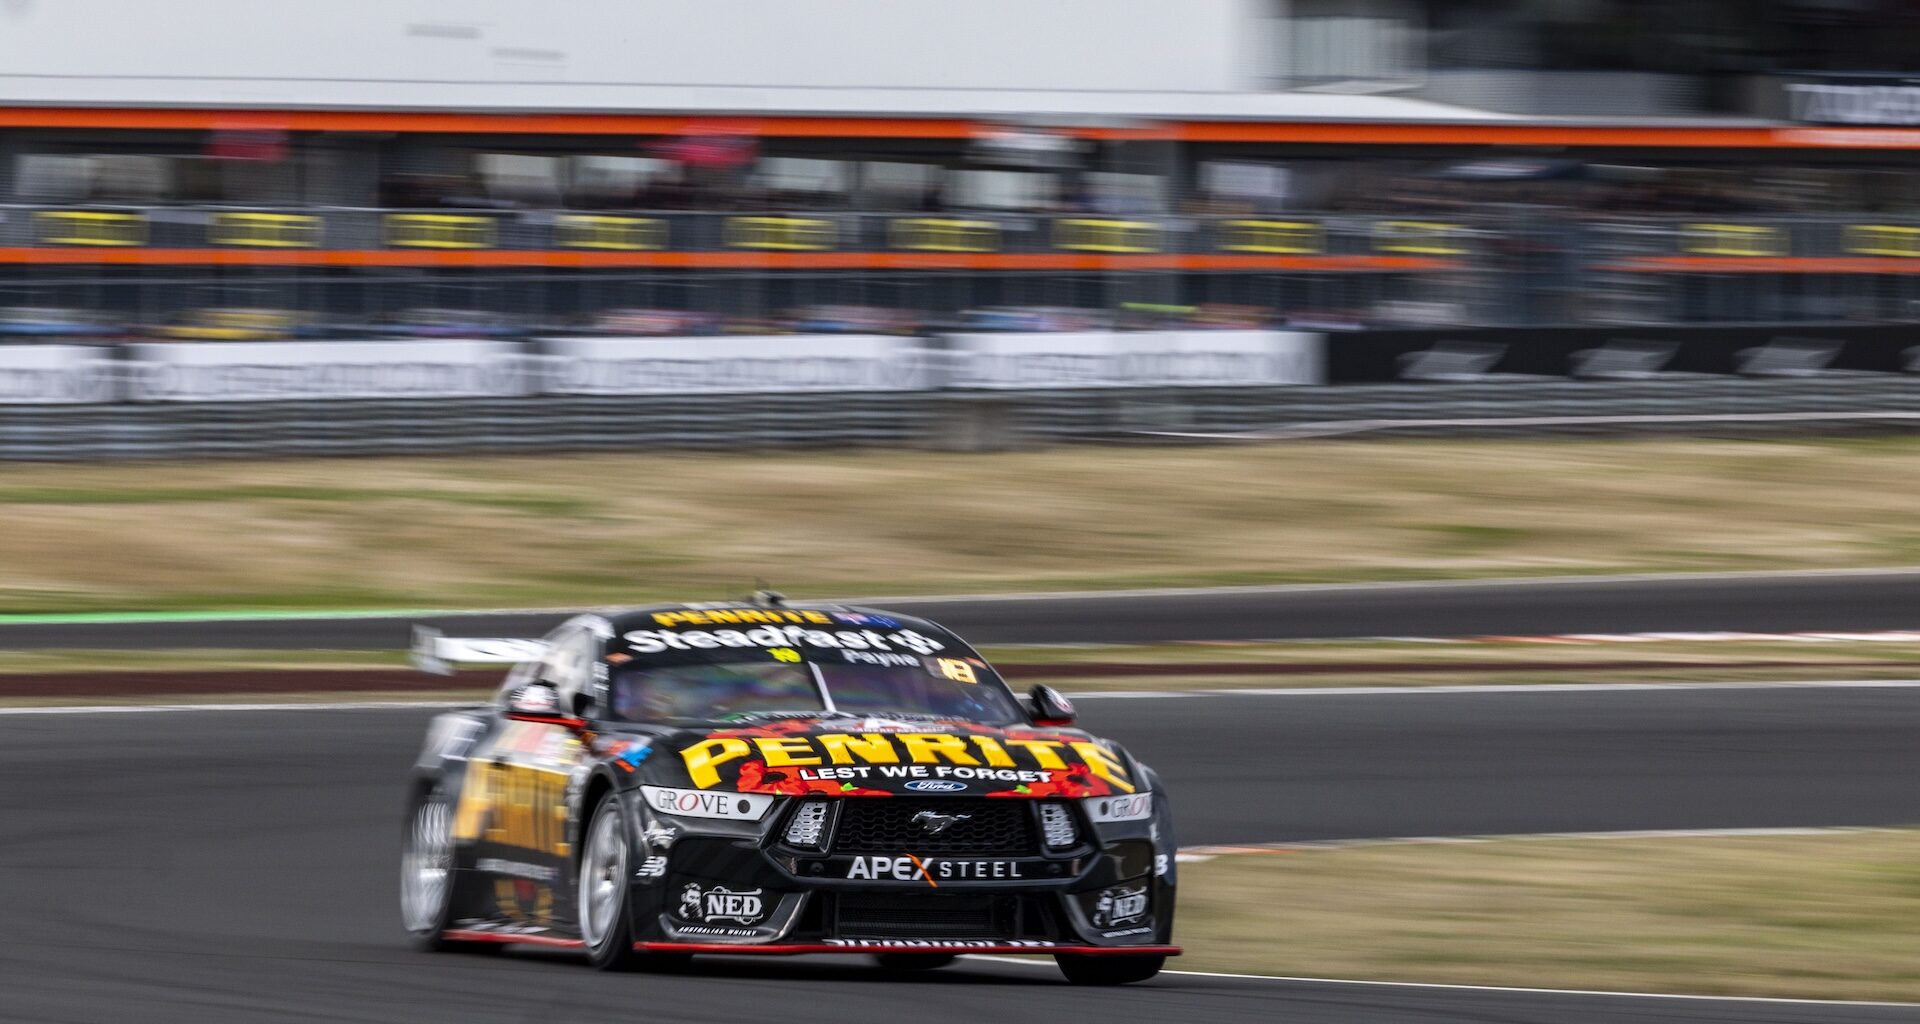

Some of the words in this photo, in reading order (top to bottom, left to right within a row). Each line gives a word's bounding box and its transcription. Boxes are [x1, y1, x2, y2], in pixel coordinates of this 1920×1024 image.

[651, 609, 834, 627] PENRITE
[623, 625, 892, 653] Steadfast
[841, 649, 920, 667] Payne
[679, 732, 1136, 793] PENRITE
[800, 766, 871, 781] LEST
[879, 765, 929, 778] WE
[935, 766, 1053, 783] FORGET
[656, 790, 729, 815] GROVE
[847, 854, 938, 888] APEX
[939, 862, 1022, 878] STEEL
[707, 894, 762, 916] NED
[678, 926, 725, 935] AUSTRALIAN
